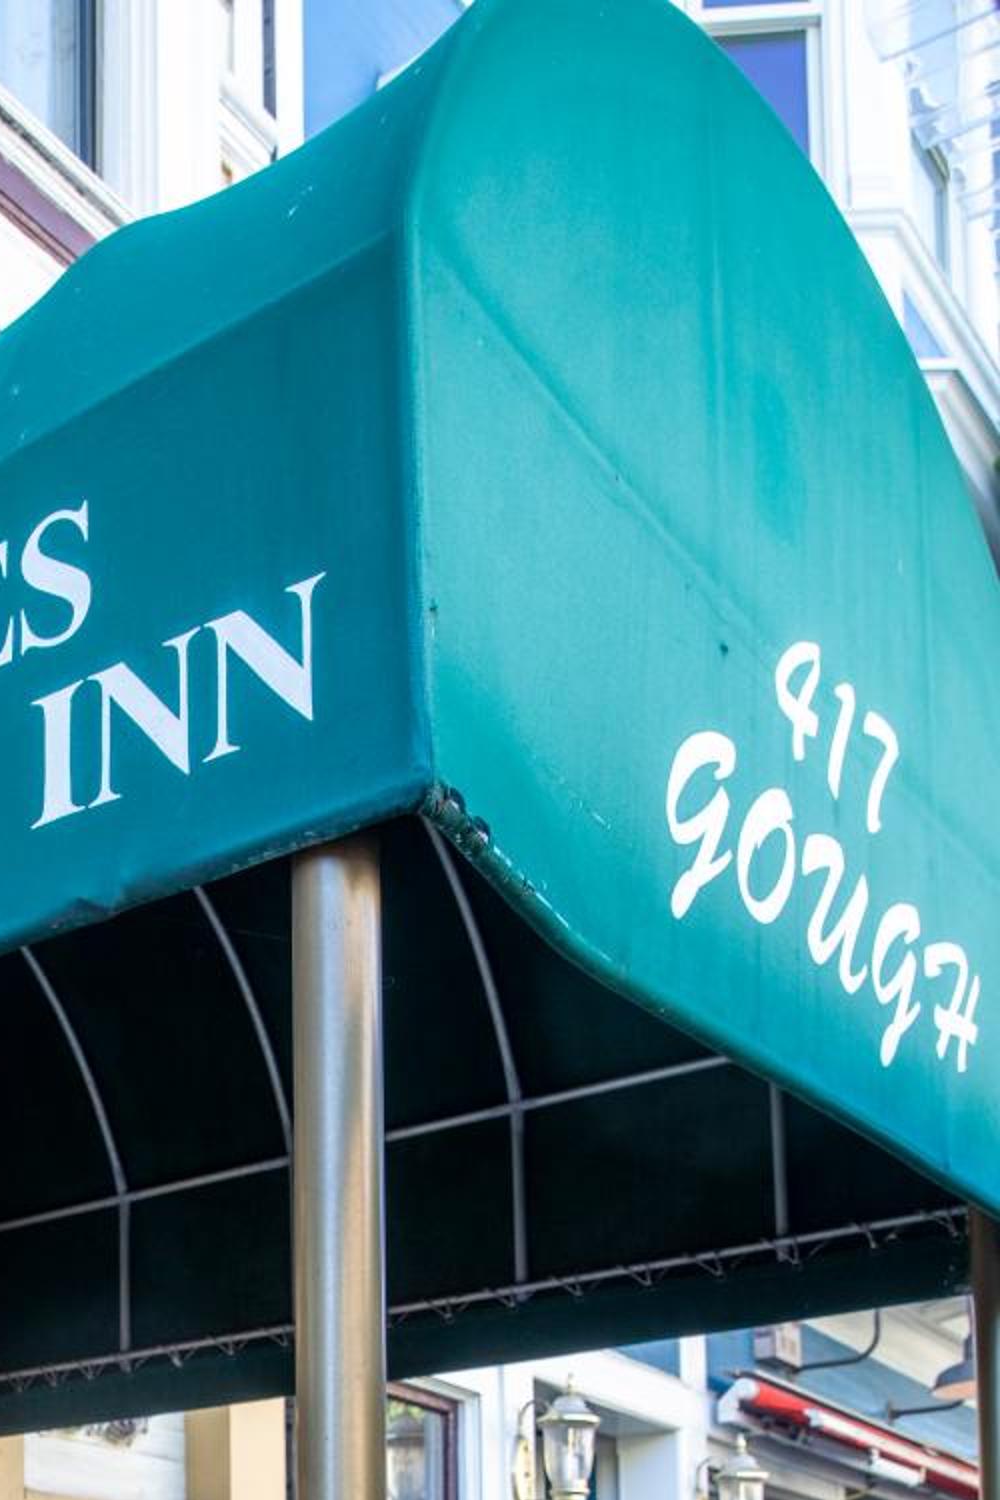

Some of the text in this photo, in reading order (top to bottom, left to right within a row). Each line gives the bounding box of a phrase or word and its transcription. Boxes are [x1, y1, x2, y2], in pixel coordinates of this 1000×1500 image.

[31, 571, 325, 829] INN
[775, 641, 899, 833] 417
[666, 731, 980, 1073] GOUGH
